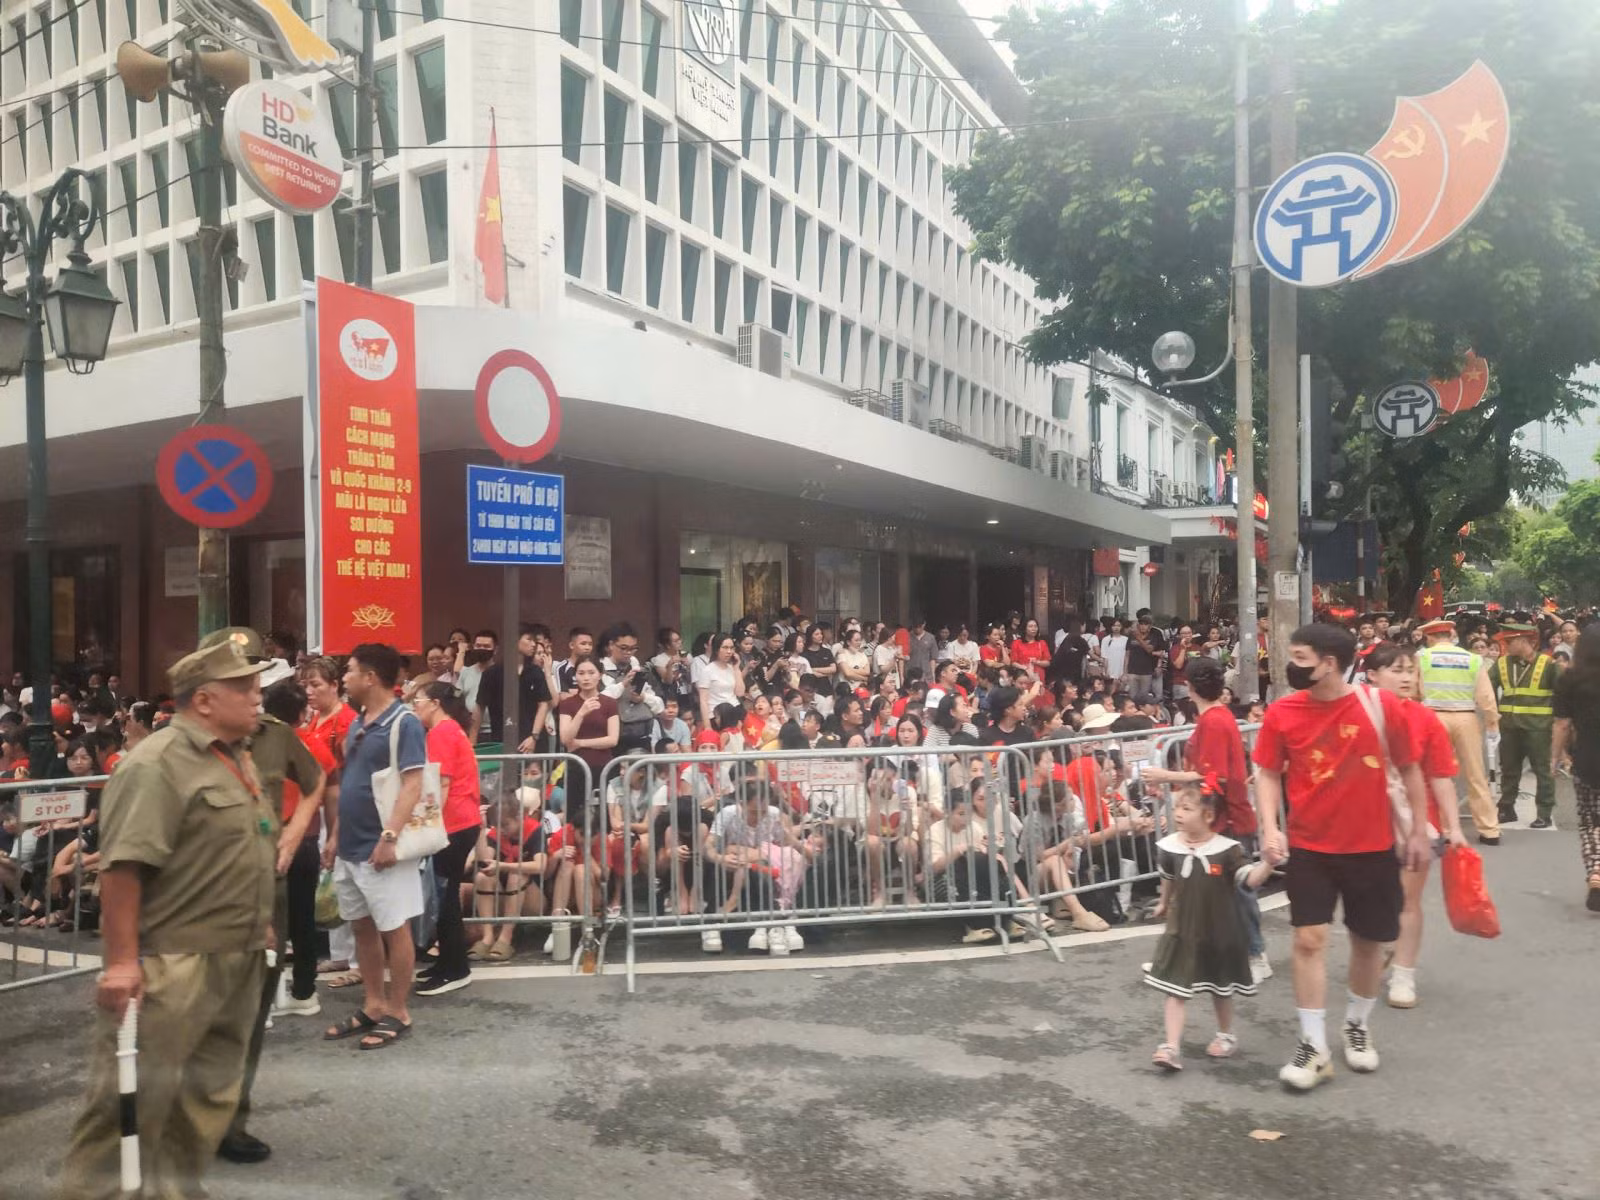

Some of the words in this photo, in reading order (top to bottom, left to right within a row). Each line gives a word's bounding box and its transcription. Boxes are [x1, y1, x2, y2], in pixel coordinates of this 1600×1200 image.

[262, 92, 295, 124] HD
[262, 115, 318, 158] Bank
[247, 143, 301, 171] COMMITTED
[300, 164, 315, 177] TO
[313, 171, 337, 188] YOUR
[285, 171, 322, 193] RETURNS
[330, 467, 342, 486] VÀ
[354, 492, 365, 511] LÀ
[477, 476, 511, 503] TUYẾN
[513, 480, 534, 506] PHỐ
[535, 486, 545, 506] ĐI
[546, 485, 559, 512] BỘ
